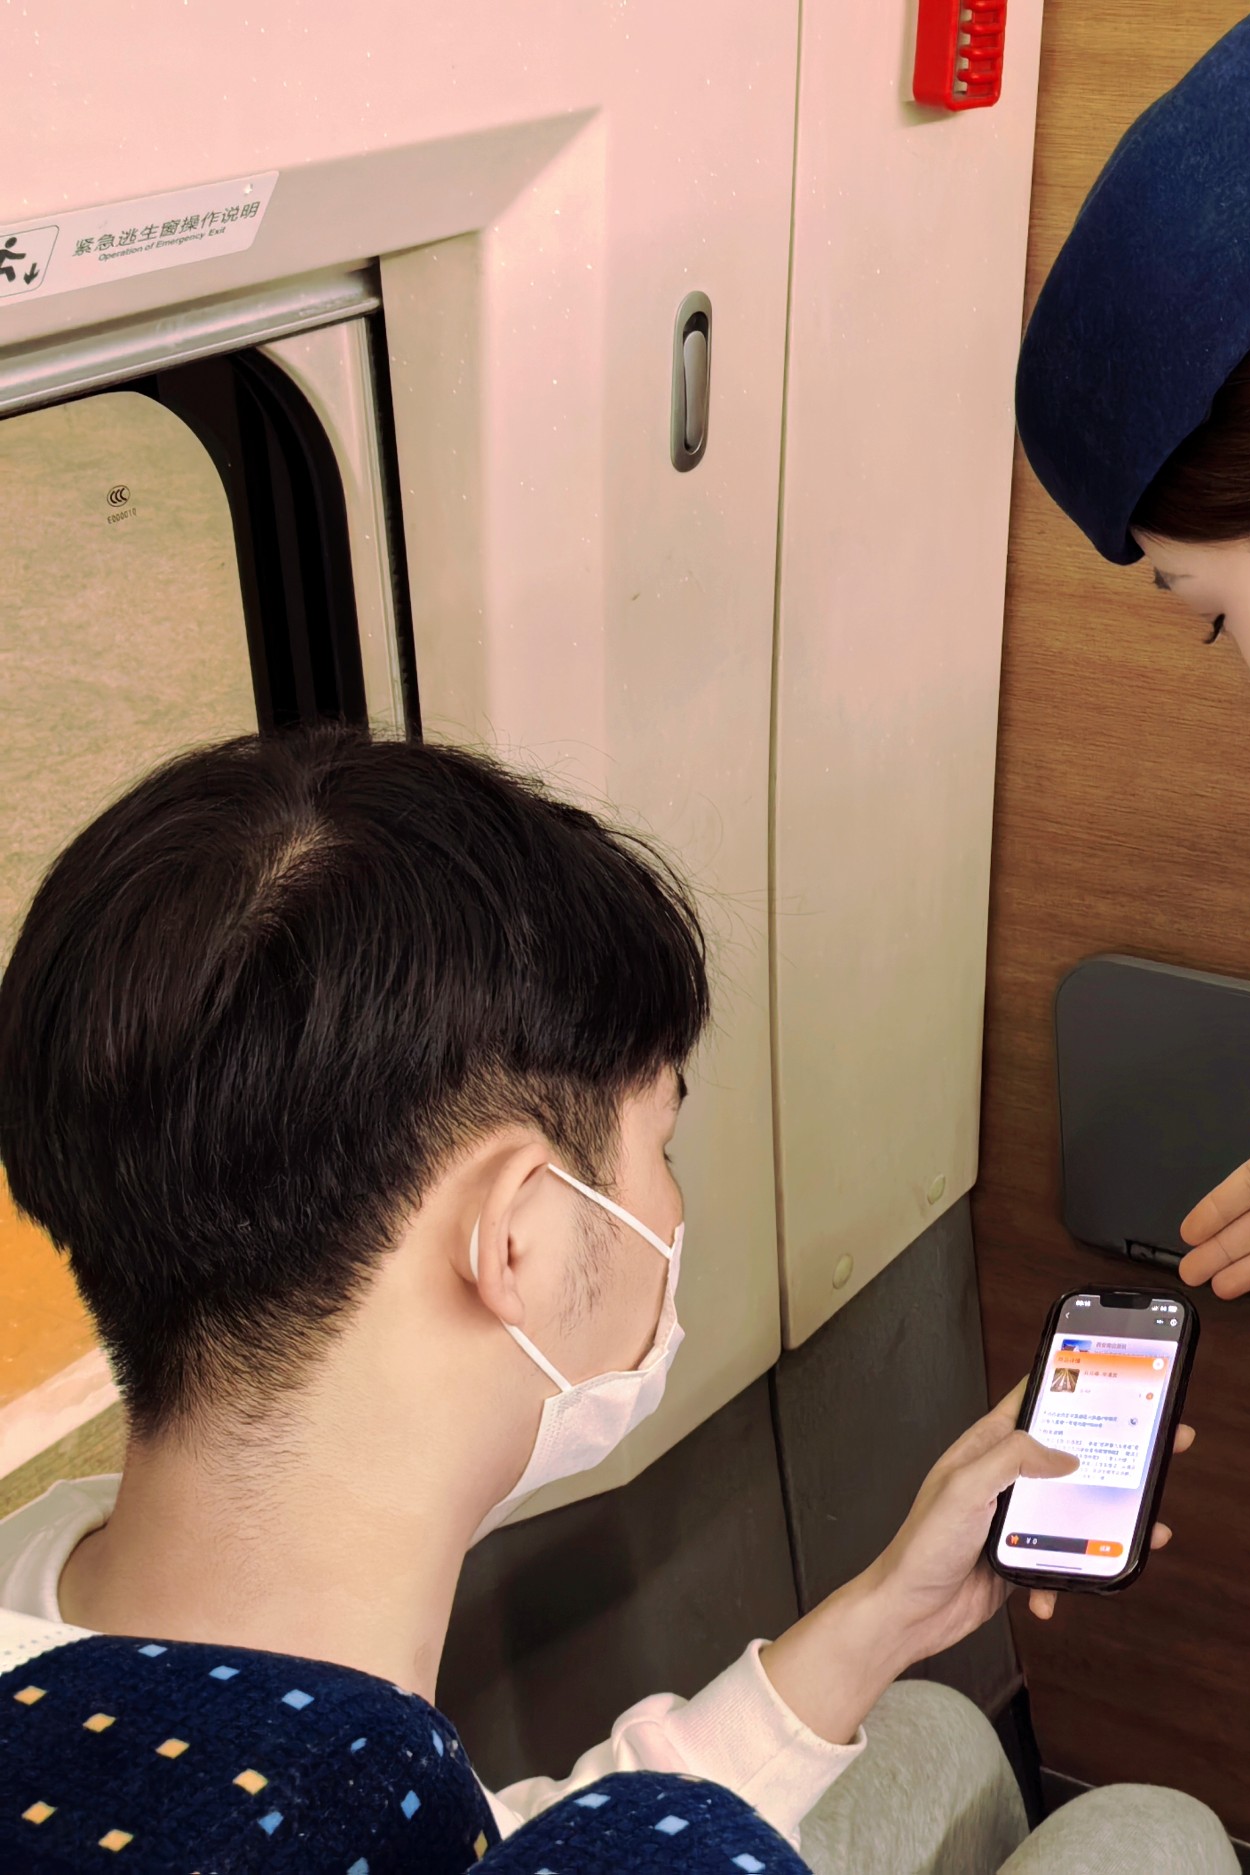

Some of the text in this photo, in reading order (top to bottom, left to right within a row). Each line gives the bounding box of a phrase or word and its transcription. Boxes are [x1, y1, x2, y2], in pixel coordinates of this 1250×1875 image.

[72, 201, 260, 257] 紧急逃生窗操作说明
[98, 227, 226, 262] Operation of Emergency Exit
